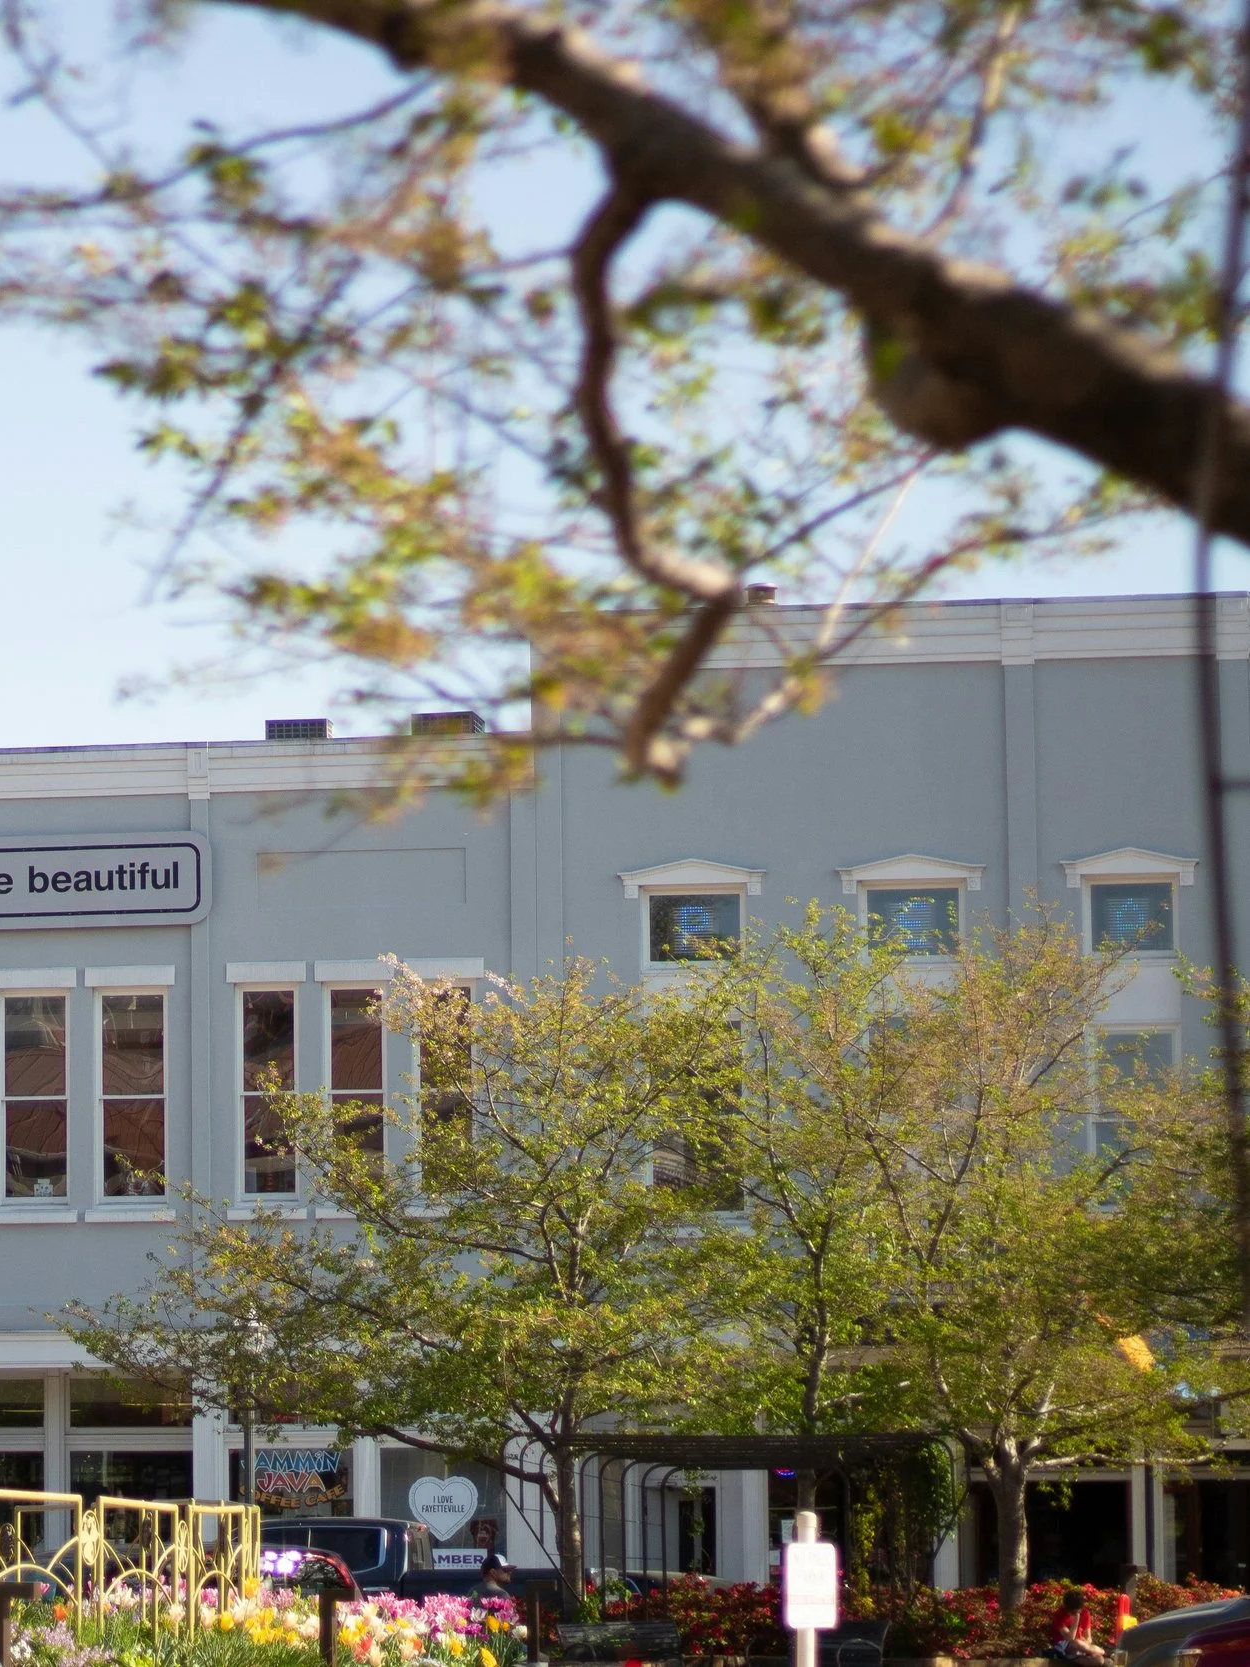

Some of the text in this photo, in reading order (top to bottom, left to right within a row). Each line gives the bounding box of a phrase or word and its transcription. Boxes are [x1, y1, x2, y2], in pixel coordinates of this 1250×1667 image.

[28, 861, 180, 894] beautiful
[240, 1450, 340, 1473] AMMiN
[256, 1471, 326, 1493] JAVA
[304, 1483, 346, 1508] CAFE
[437, 1495, 454, 1504] LOVE
[421, 1504, 465, 1513] FAYETTEVILLE
